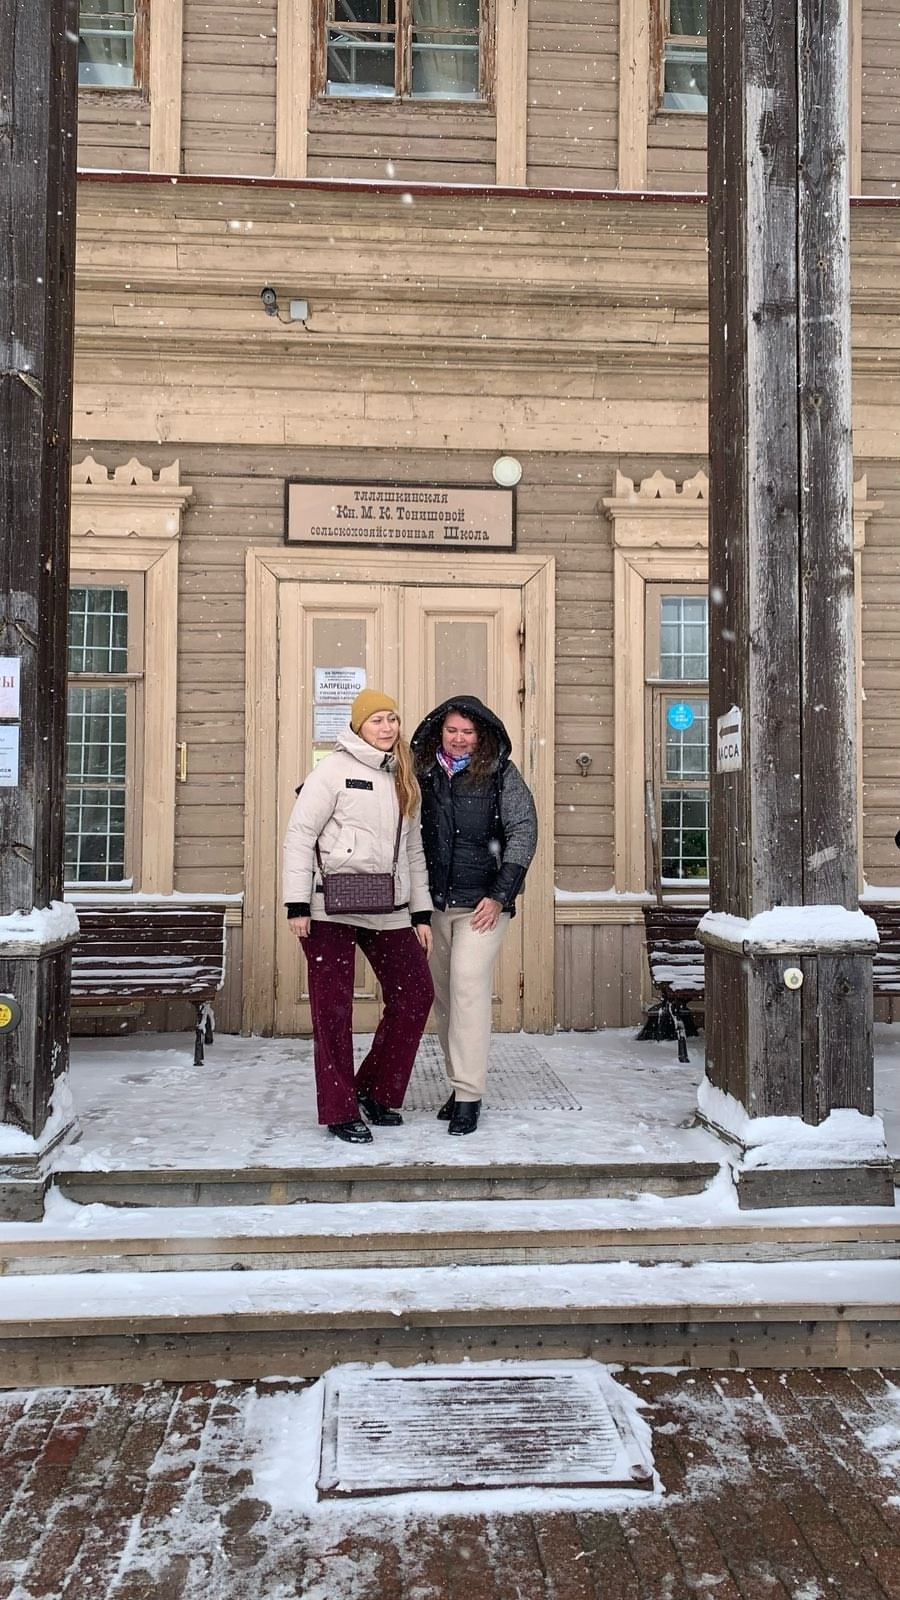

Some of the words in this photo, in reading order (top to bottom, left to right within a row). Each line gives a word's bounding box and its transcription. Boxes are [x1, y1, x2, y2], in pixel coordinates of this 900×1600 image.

[336, 505, 358, 519] Кн.
[361, 506, 376, 520] М.
[379, 506, 393, 520] К.
[396, 507, 465, 521] Тенишевой
[310, 526, 434, 539] сельскохозяйственная
[444, 526, 490, 540] Школа
[0, 676, 14, 688] Ы
